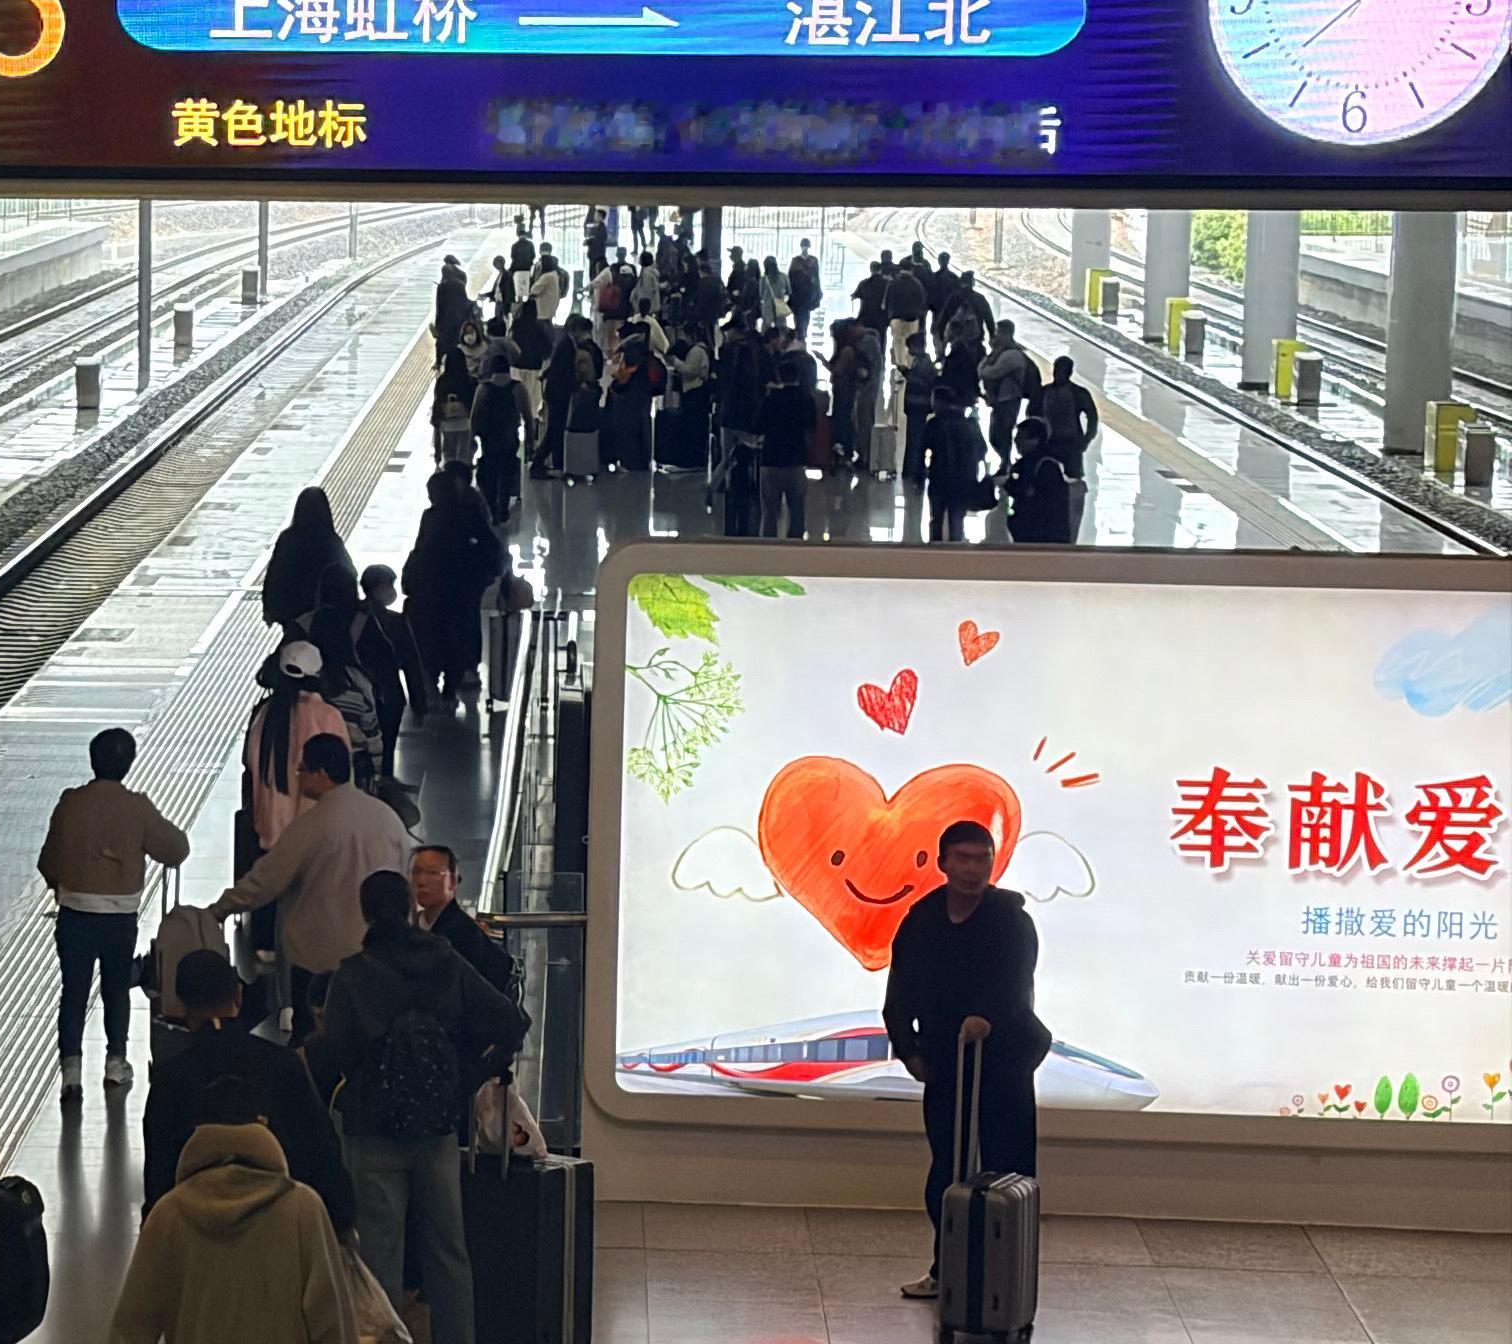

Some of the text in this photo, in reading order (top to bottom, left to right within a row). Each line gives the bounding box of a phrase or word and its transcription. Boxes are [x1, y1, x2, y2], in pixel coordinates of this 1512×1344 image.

[170, 97, 368, 150] 黄色地标
[1341, 90, 1368, 134] 6
[1169, 765, 1505, 876] 奉献爱
[1300, 906, 1500, 940] 播撒爱的阳光
[1245, 950, 1512, 974] 关爱留守儿童为祖国的未来撑起一片
